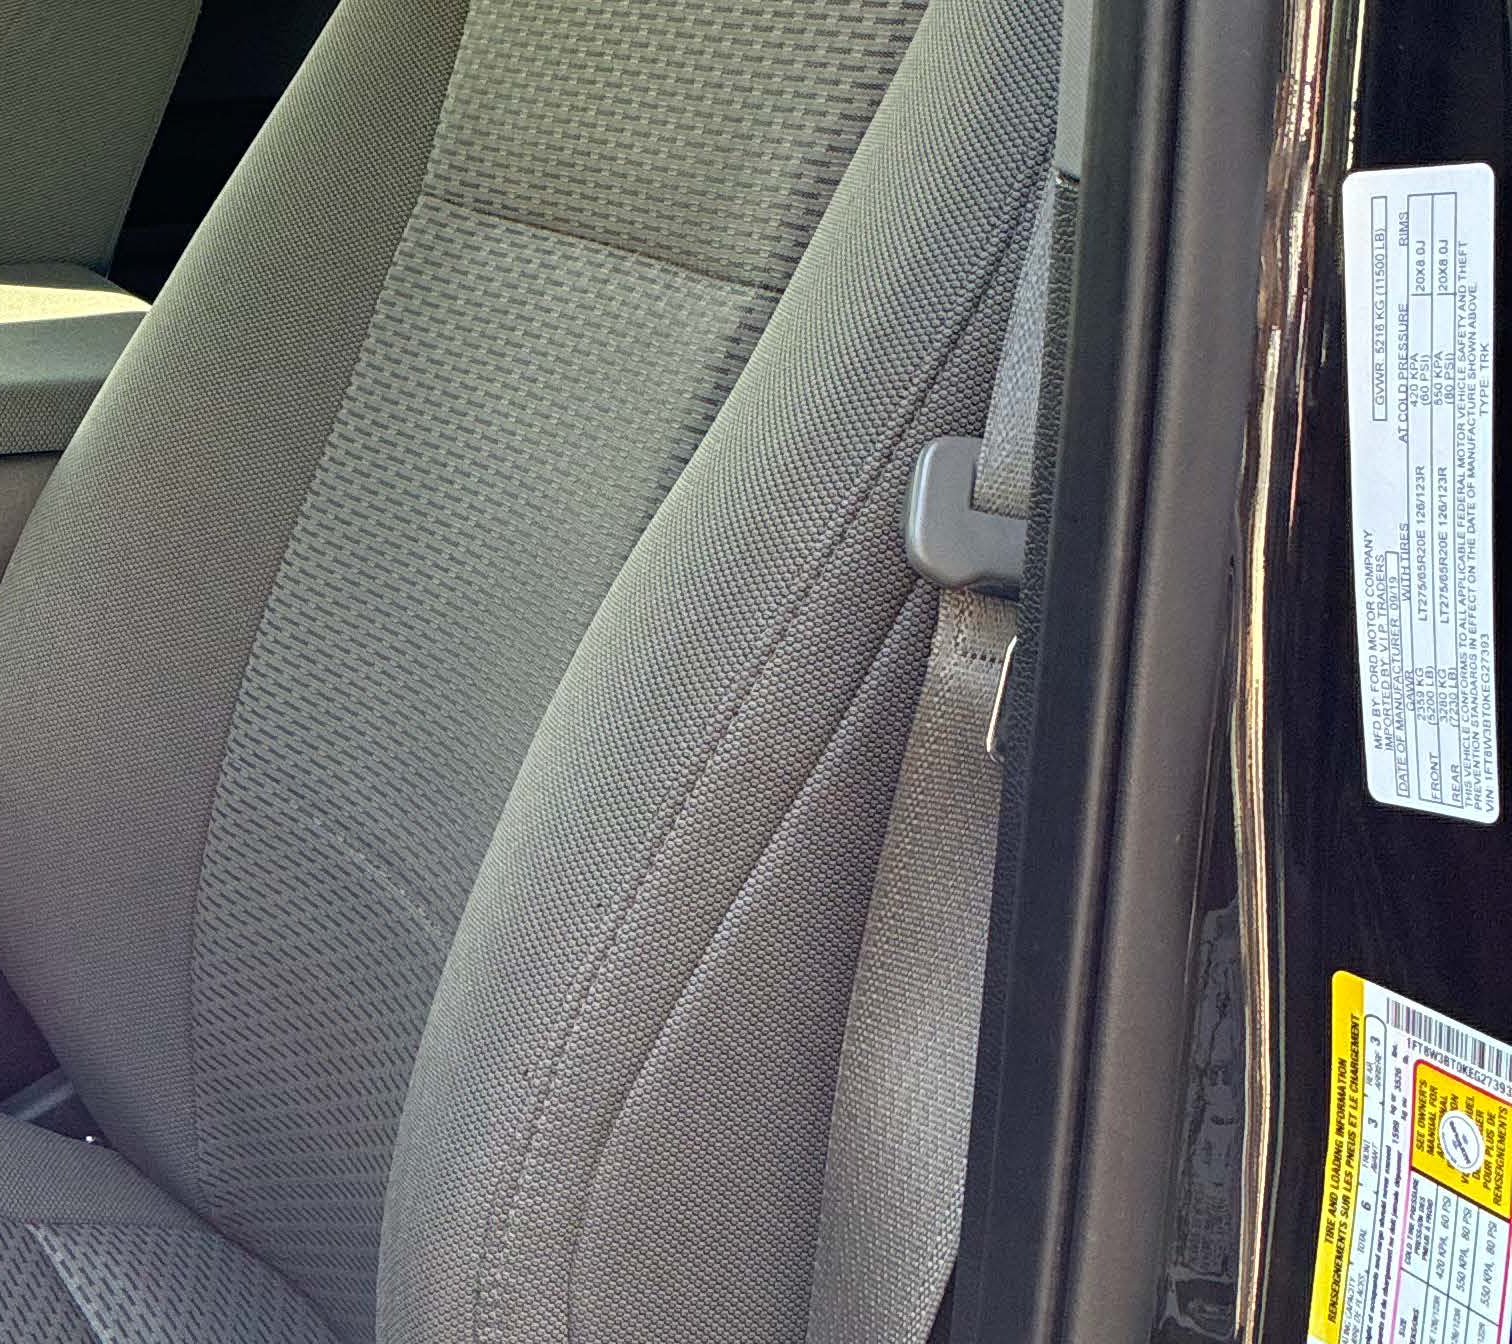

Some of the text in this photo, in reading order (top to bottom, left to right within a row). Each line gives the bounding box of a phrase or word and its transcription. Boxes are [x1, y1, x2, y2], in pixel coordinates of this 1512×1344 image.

[1458, 241, 1467, 281] THEFT
[1375, 228, 1385, 405] GVWR: 5216 KG (11500 LB)
[1458, 285, 1466, 311] AND
[1434, 351, 1442, 377] KPA
[1458, 315, 1466, 362] SAFETY
[1468, 328, 1476, 379] SHOWN
[1480, 343, 1489, 370] TRK
[1410, 353, 1418, 407] 420 KPA
[1419, 355, 1430, 406] (60 PSI)
[1445, 353, 1454, 380] PSI)
[1457, 366, 1466, 419] VEHICLE
[1456, 422, 1466, 468] MOTOR
[1467, 384, 1476, 478] MANUFACTURE
[1398, 212, 1415, 711] GAWR WITH TIRES AT COLD PRESSURE RIMS
[1457, 472, 1466, 527] FEDERAL
[1467, 503, 1475, 534] DATE
[1363, 529, 1374, 597] COMPANY
[1415, 466, 1427, 621] LT275/65R20E 126/123R
[1438, 467, 1449, 624] LT275/65R20E 126/123R
[1457, 532, 1466, 606] APPLICABLE
[1467, 539, 1475, 561] THE
[1375, 554, 1387, 616] TRADERS
[1389, 576, 1399, 610] 09/19
[1367, 601, 1377, 650] MOTOR
[1458, 610, 1466, 628] ALL
[1468, 588, 1476, 634] EFFECT
[1369, 655, 1379, 692] FORD
[1460, 653, 1469, 722] CONFORMS
[1470, 654, 1479, 728] STANDARDS
[1381, 681, 1393, 751] IMPORTED
[1417, 691, 1426, 720] 2359
[1439, 692, 1448, 723] 3280
[1373, 721, 1382, 749] MFD
[1396, 735, 1405, 753] OF
[1426, 666, 1440, 800] FRONT (5200 LB)
[1448, 667, 1460, 802] REAR (7230 LB)
[1462, 727, 1472, 777] VEHICLE
[1398, 757, 1408, 791] DATE
[1465, 781, 1473, 807] THIS
[1472, 731, 1482, 810] PREVENTION
[1370, 1034, 1380, 1048] 3
[1367, 1116, 1377, 1130] 3
[1415, 1078, 1428, 1153] SEE OWNER'S
[1426, 1110, 1436, 1157] MANUAL
[1324, 1056, 1349, 1247] TIRE AND LOADING INFORMATION
[1485, 1128, 1494, 1158] PLUS
[1492, 1105, 1507, 1208] RENSEIGNEMENTS
[1327, 1013, 1360, 1325] RENSEIGNEMENTS SUR LES PNEUS ET LE CHARGEMENT
[1482, 1159, 1492, 1192] POUR
[1357, 1199, 1371, 1256] TOTAL 6
[1435, 1258, 1444, 1282] 420
[1441, 1194, 1451, 1215] PSI
[1455, 1270, 1465, 1294] 550
[1462, 1206, 1471, 1227] PSI
[1480, 1284, 1490, 1309] 550
[1487, 1219, 1497, 1240] PSI
